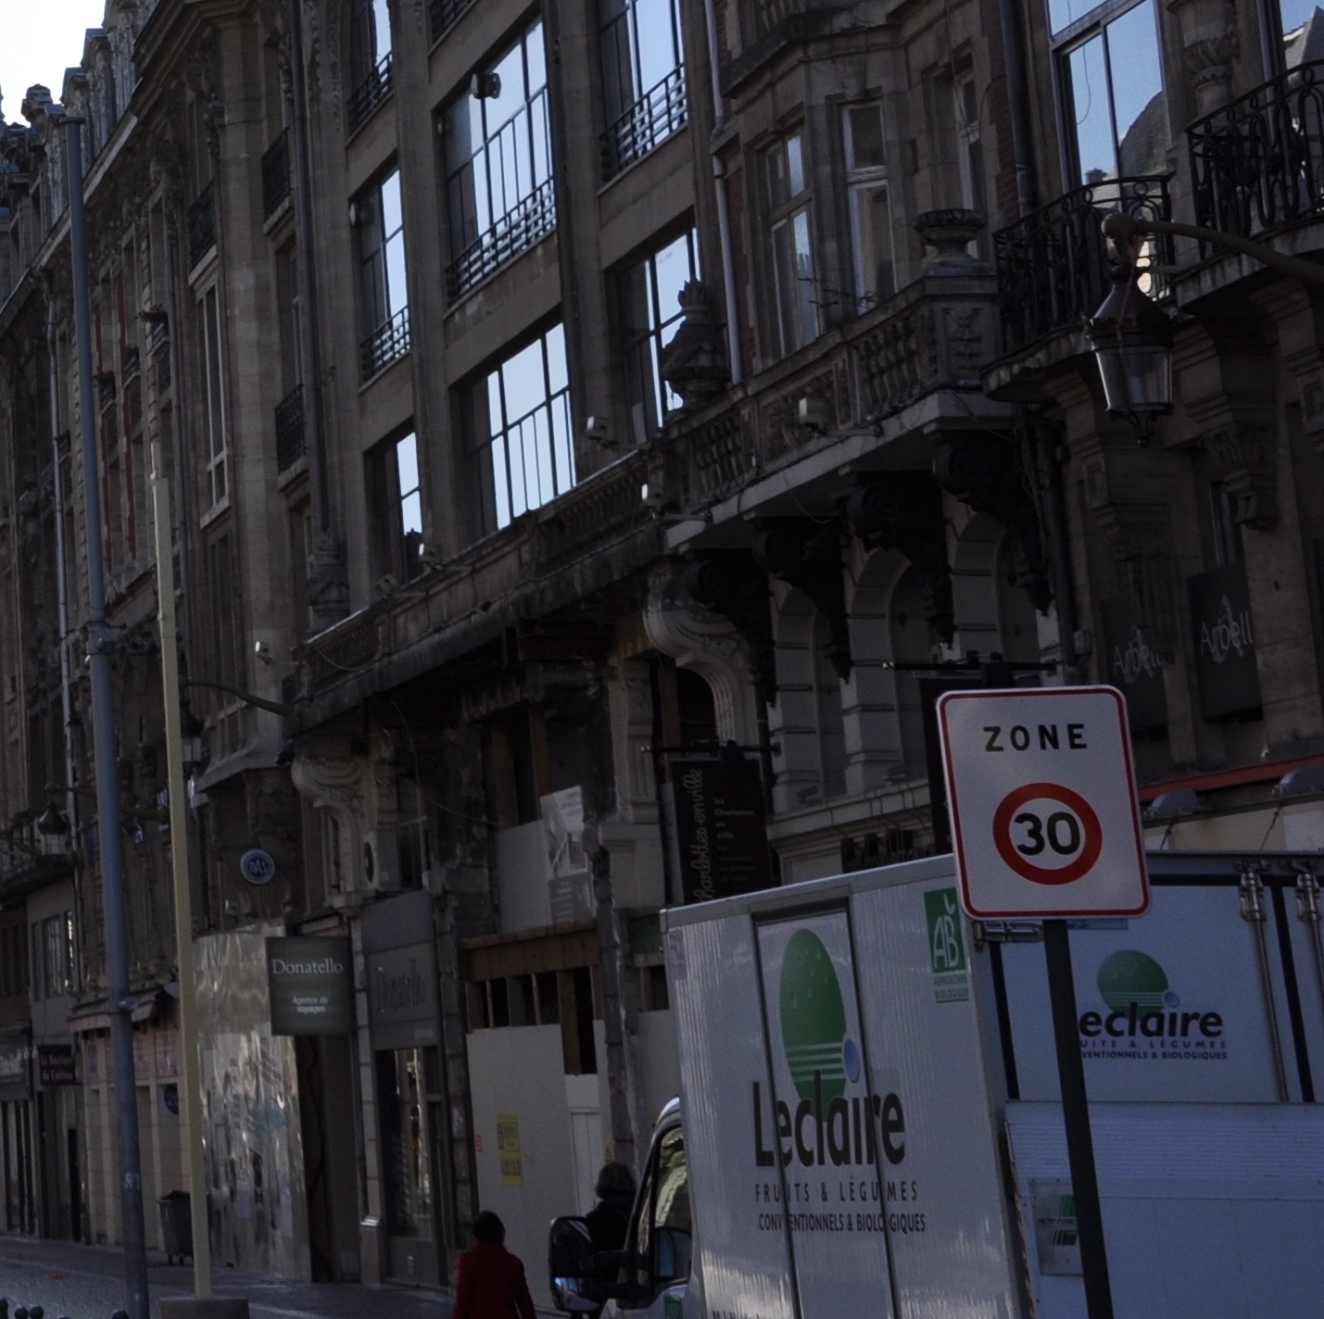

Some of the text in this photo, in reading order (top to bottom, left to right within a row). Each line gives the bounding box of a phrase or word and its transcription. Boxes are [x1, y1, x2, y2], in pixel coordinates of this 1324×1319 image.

[982, 723, 1088, 753] ZONE
[1014, 812, 1081, 856] 30
[272, 958, 344, 975] Donatello
[1079, 1001, 1224, 1038] eclaire
[1080, 1040, 1117, 1048] UITS
[1081, 1051, 1148, 1060] VENTIONNELS
[752, 1069, 906, 1168] Leclaire
[755, 1176, 918, 1203] FRUITS & LÉGUMES
[759, 1213, 844, 1231] CONVENTIONNELS
[857, 1213, 926, 1234] BIOLOGIQUES
